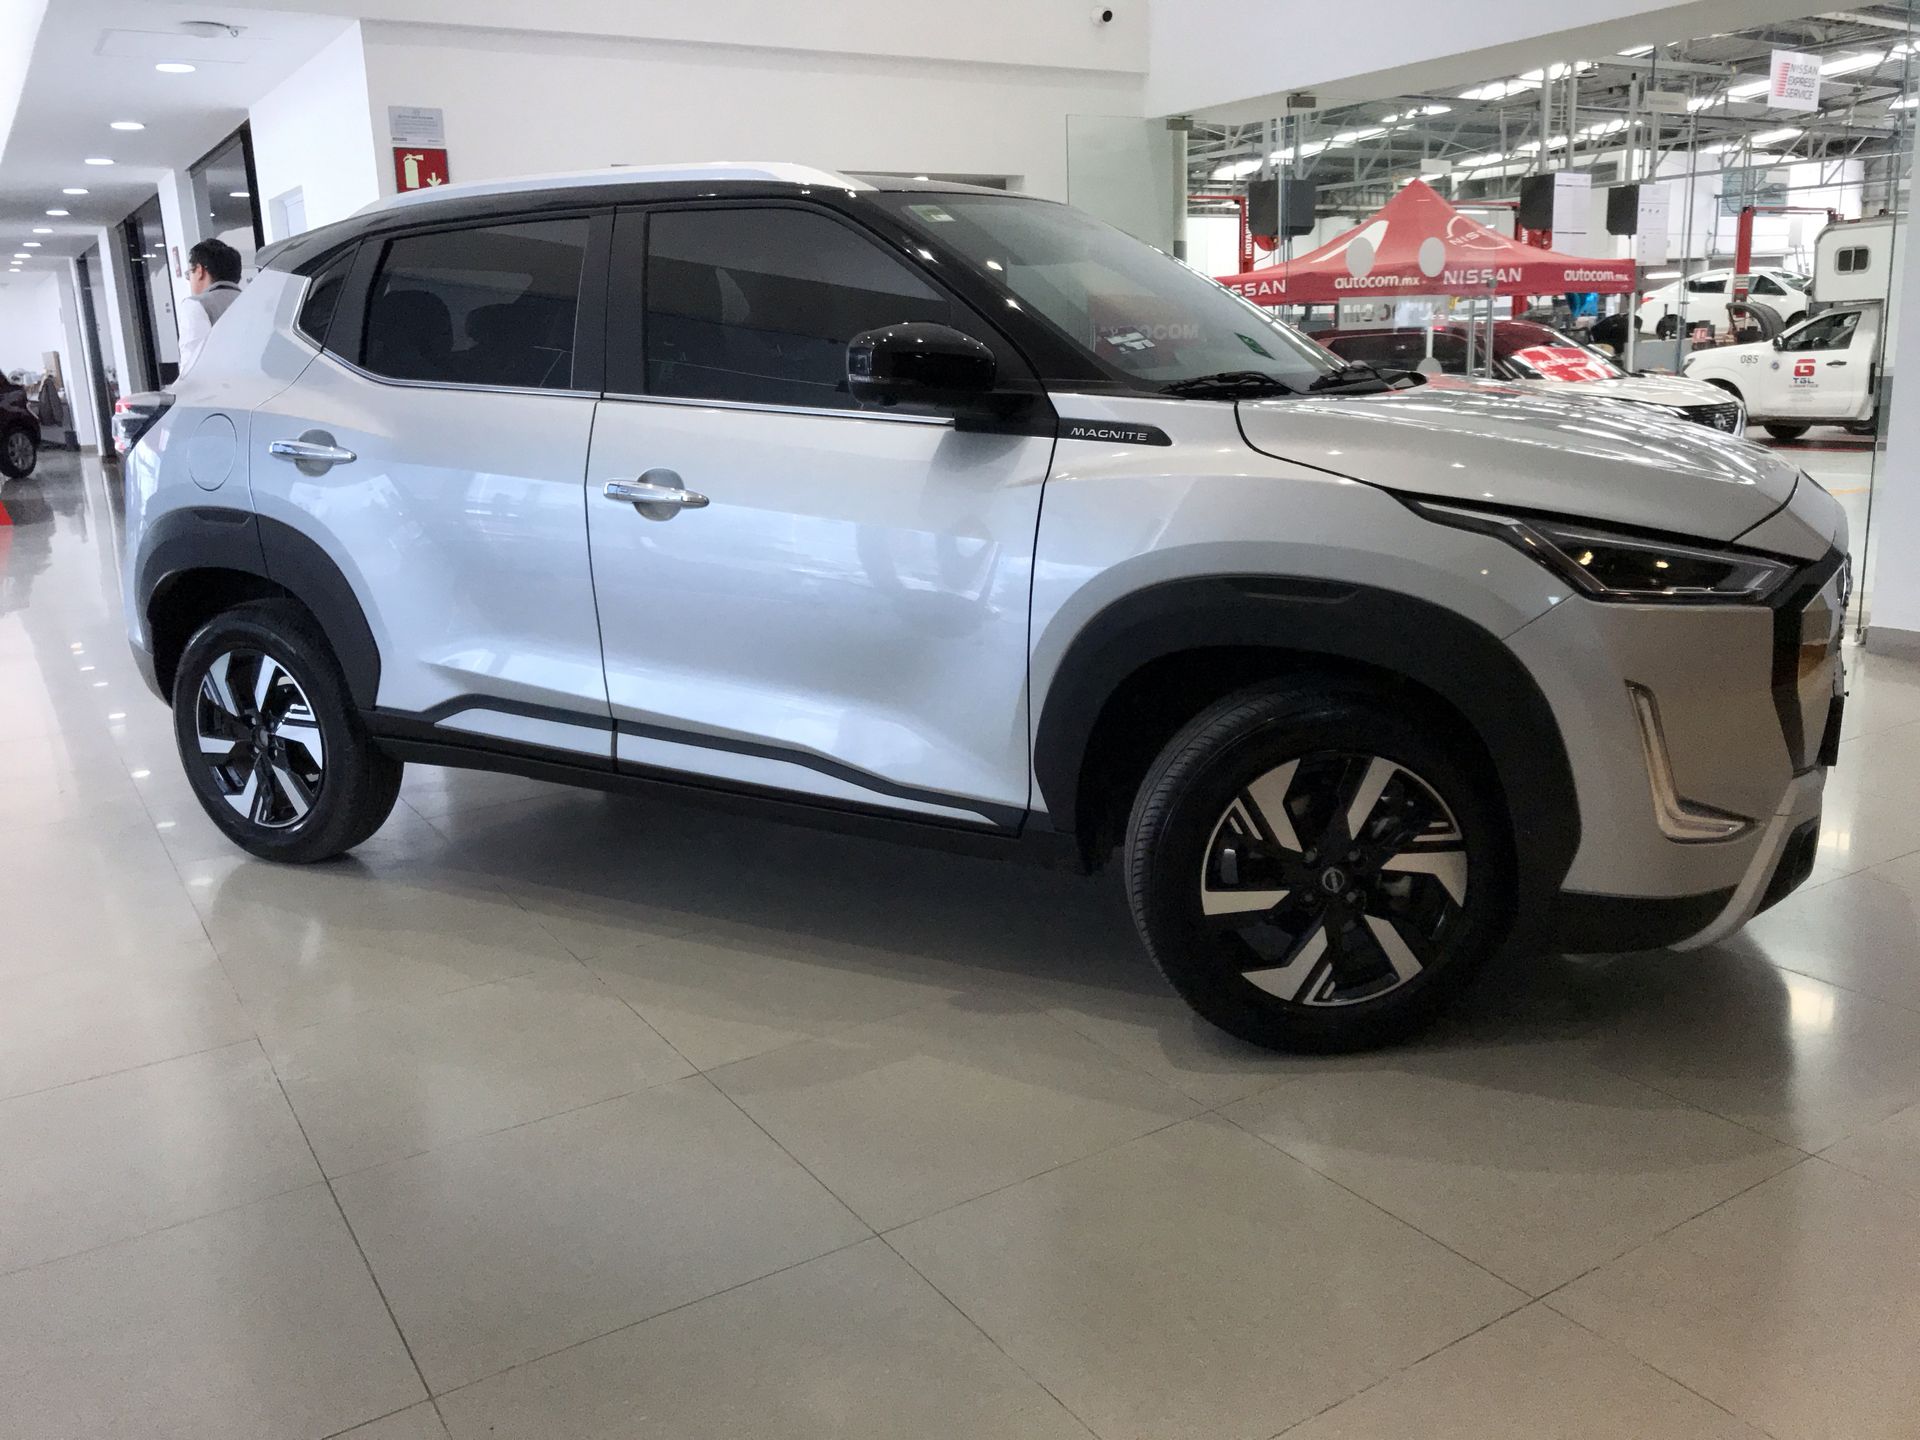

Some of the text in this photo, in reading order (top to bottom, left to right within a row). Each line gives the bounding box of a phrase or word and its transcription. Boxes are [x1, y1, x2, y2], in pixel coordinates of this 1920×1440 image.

[1790, 63, 1819, 75] NISSAN
[1787, 75, 1816, 88] EXPRESS
[1784, 87, 1814, 100] SERVICE
[1443, 267, 1522, 285] NISSAN
[1070, 427, 1149, 441] MAGNITE
